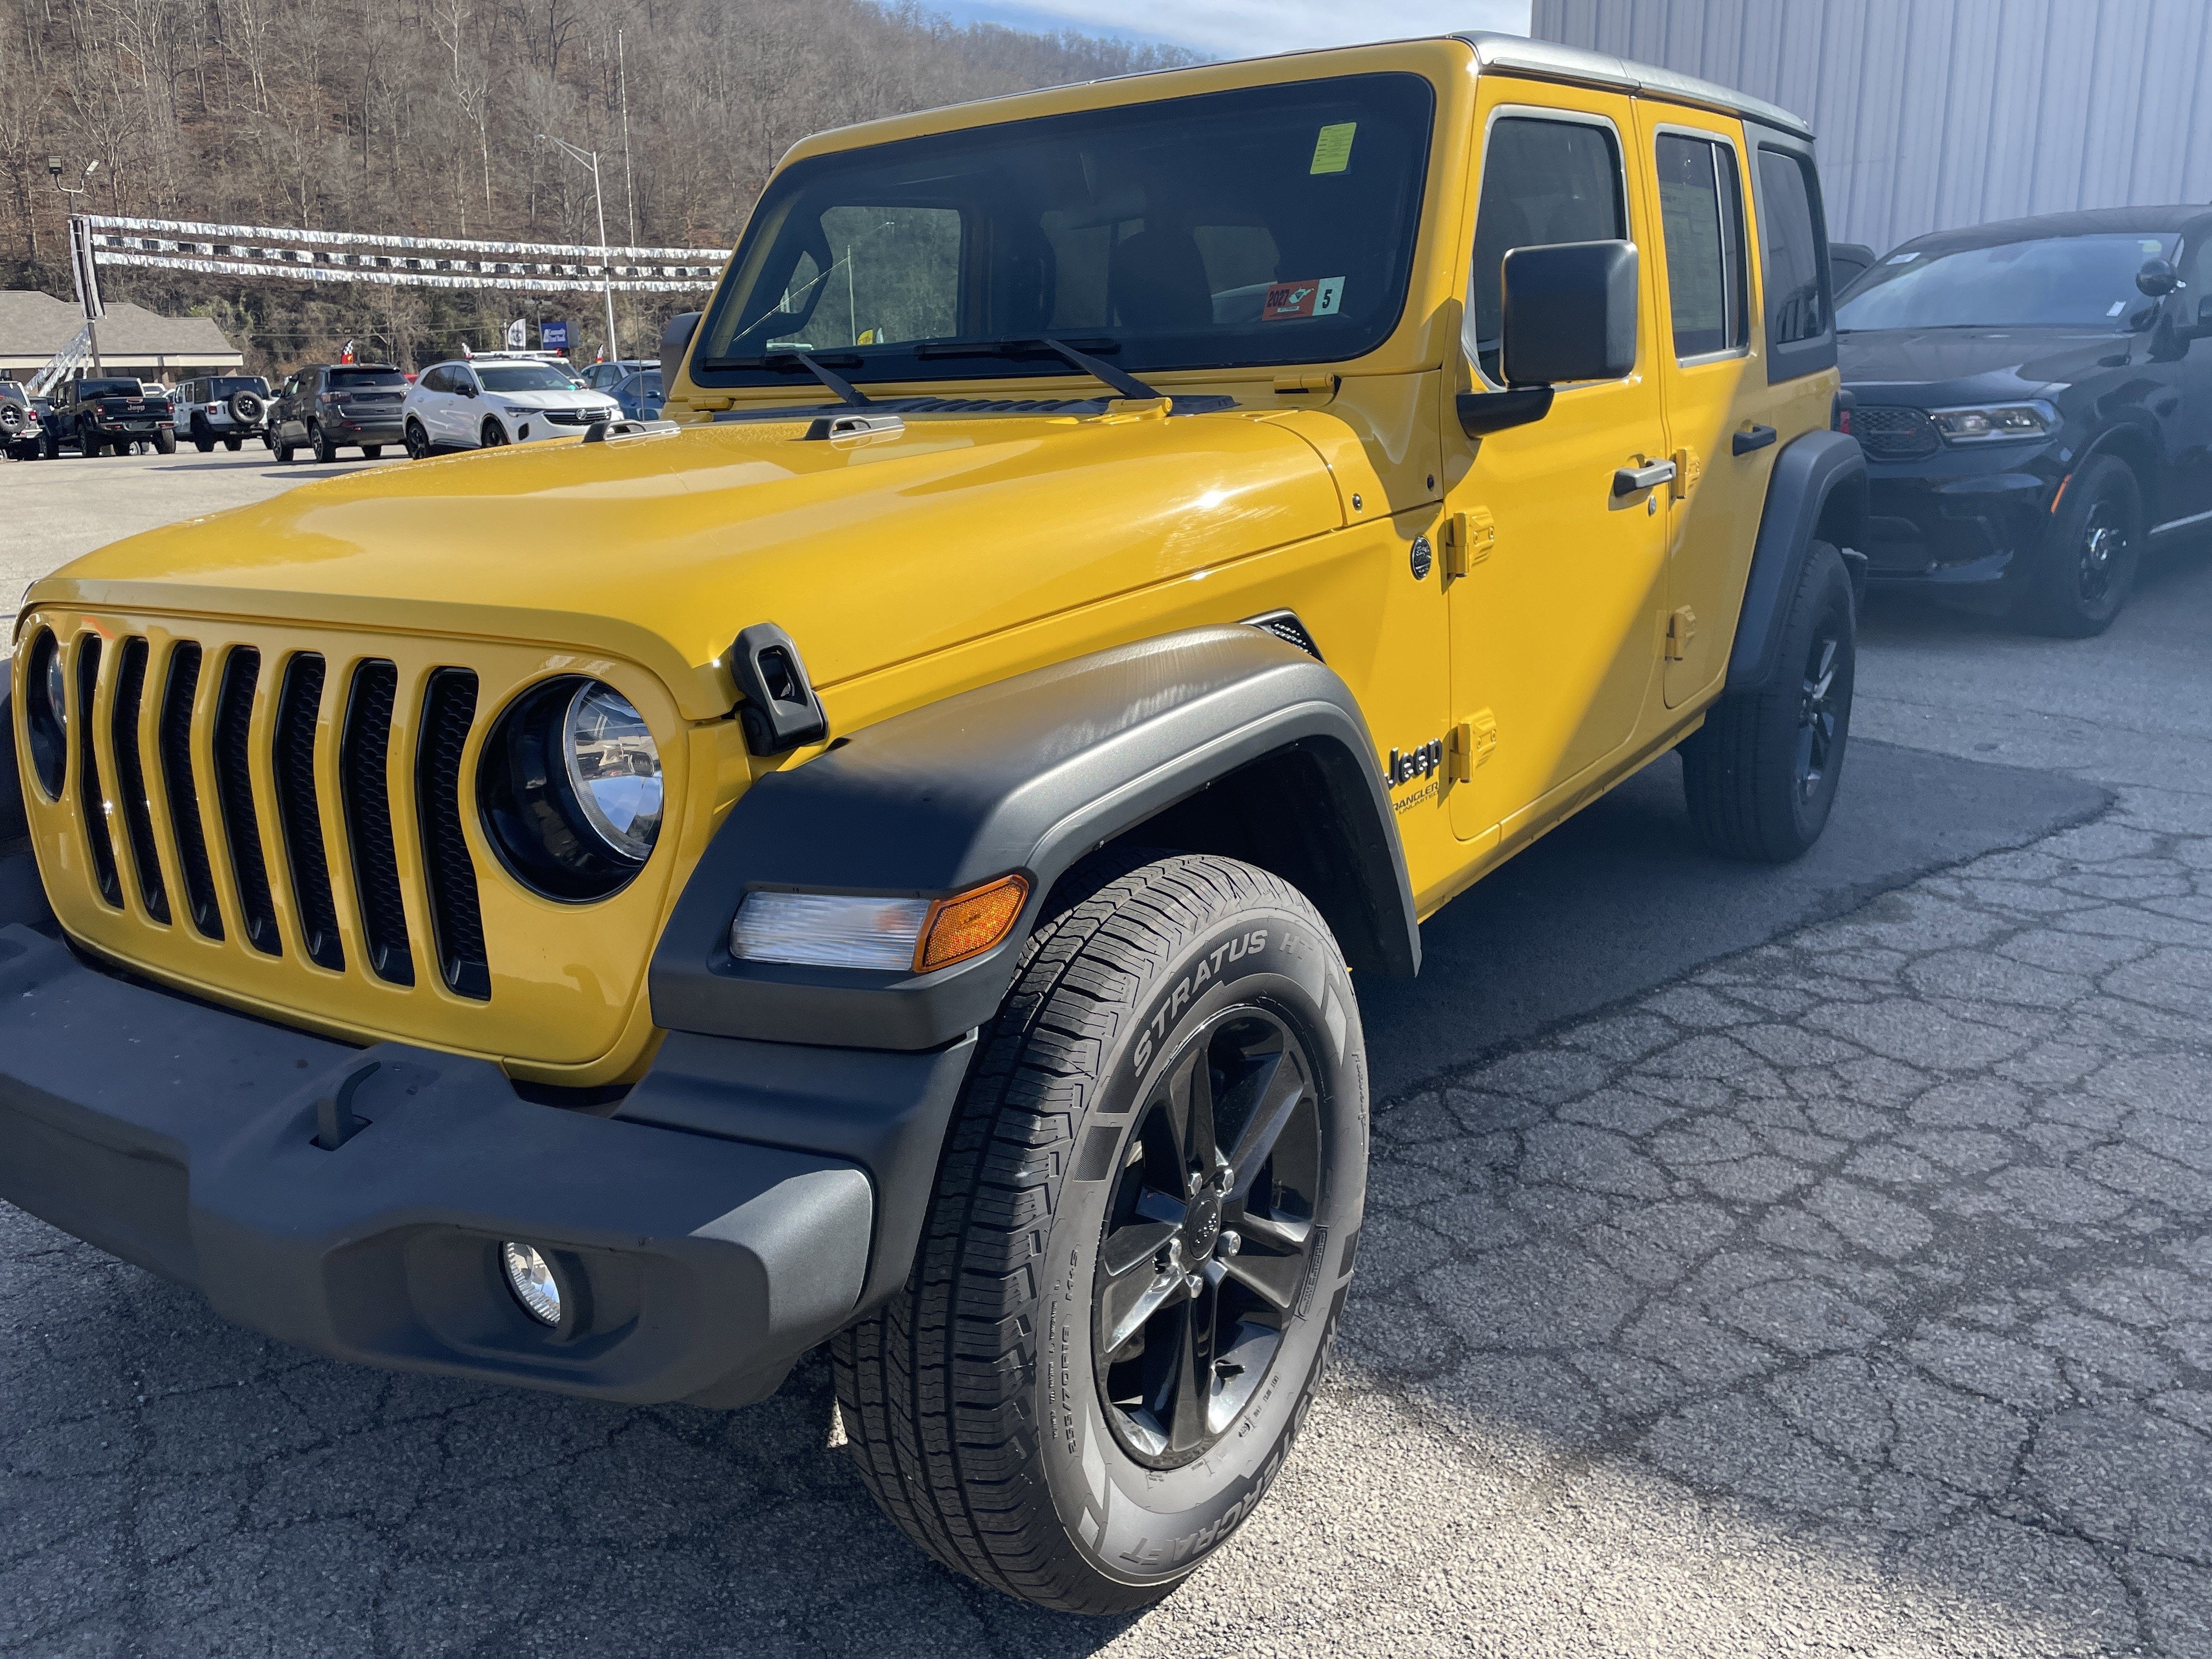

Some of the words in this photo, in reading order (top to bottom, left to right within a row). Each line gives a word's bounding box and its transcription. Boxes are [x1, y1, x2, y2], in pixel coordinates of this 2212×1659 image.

[1267, 289, 1289, 307] 2027
[1322, 289, 1333, 309] 5
[1384, 738, 1442, 790] Jeep
[1392, 782, 1438, 811] RANGLER
[1133, 929, 1268, 1077] STRATUS
[1278, 932, 1314, 960] HT
[1119, 1314, 1336, 1566] MASTERCRAFT
